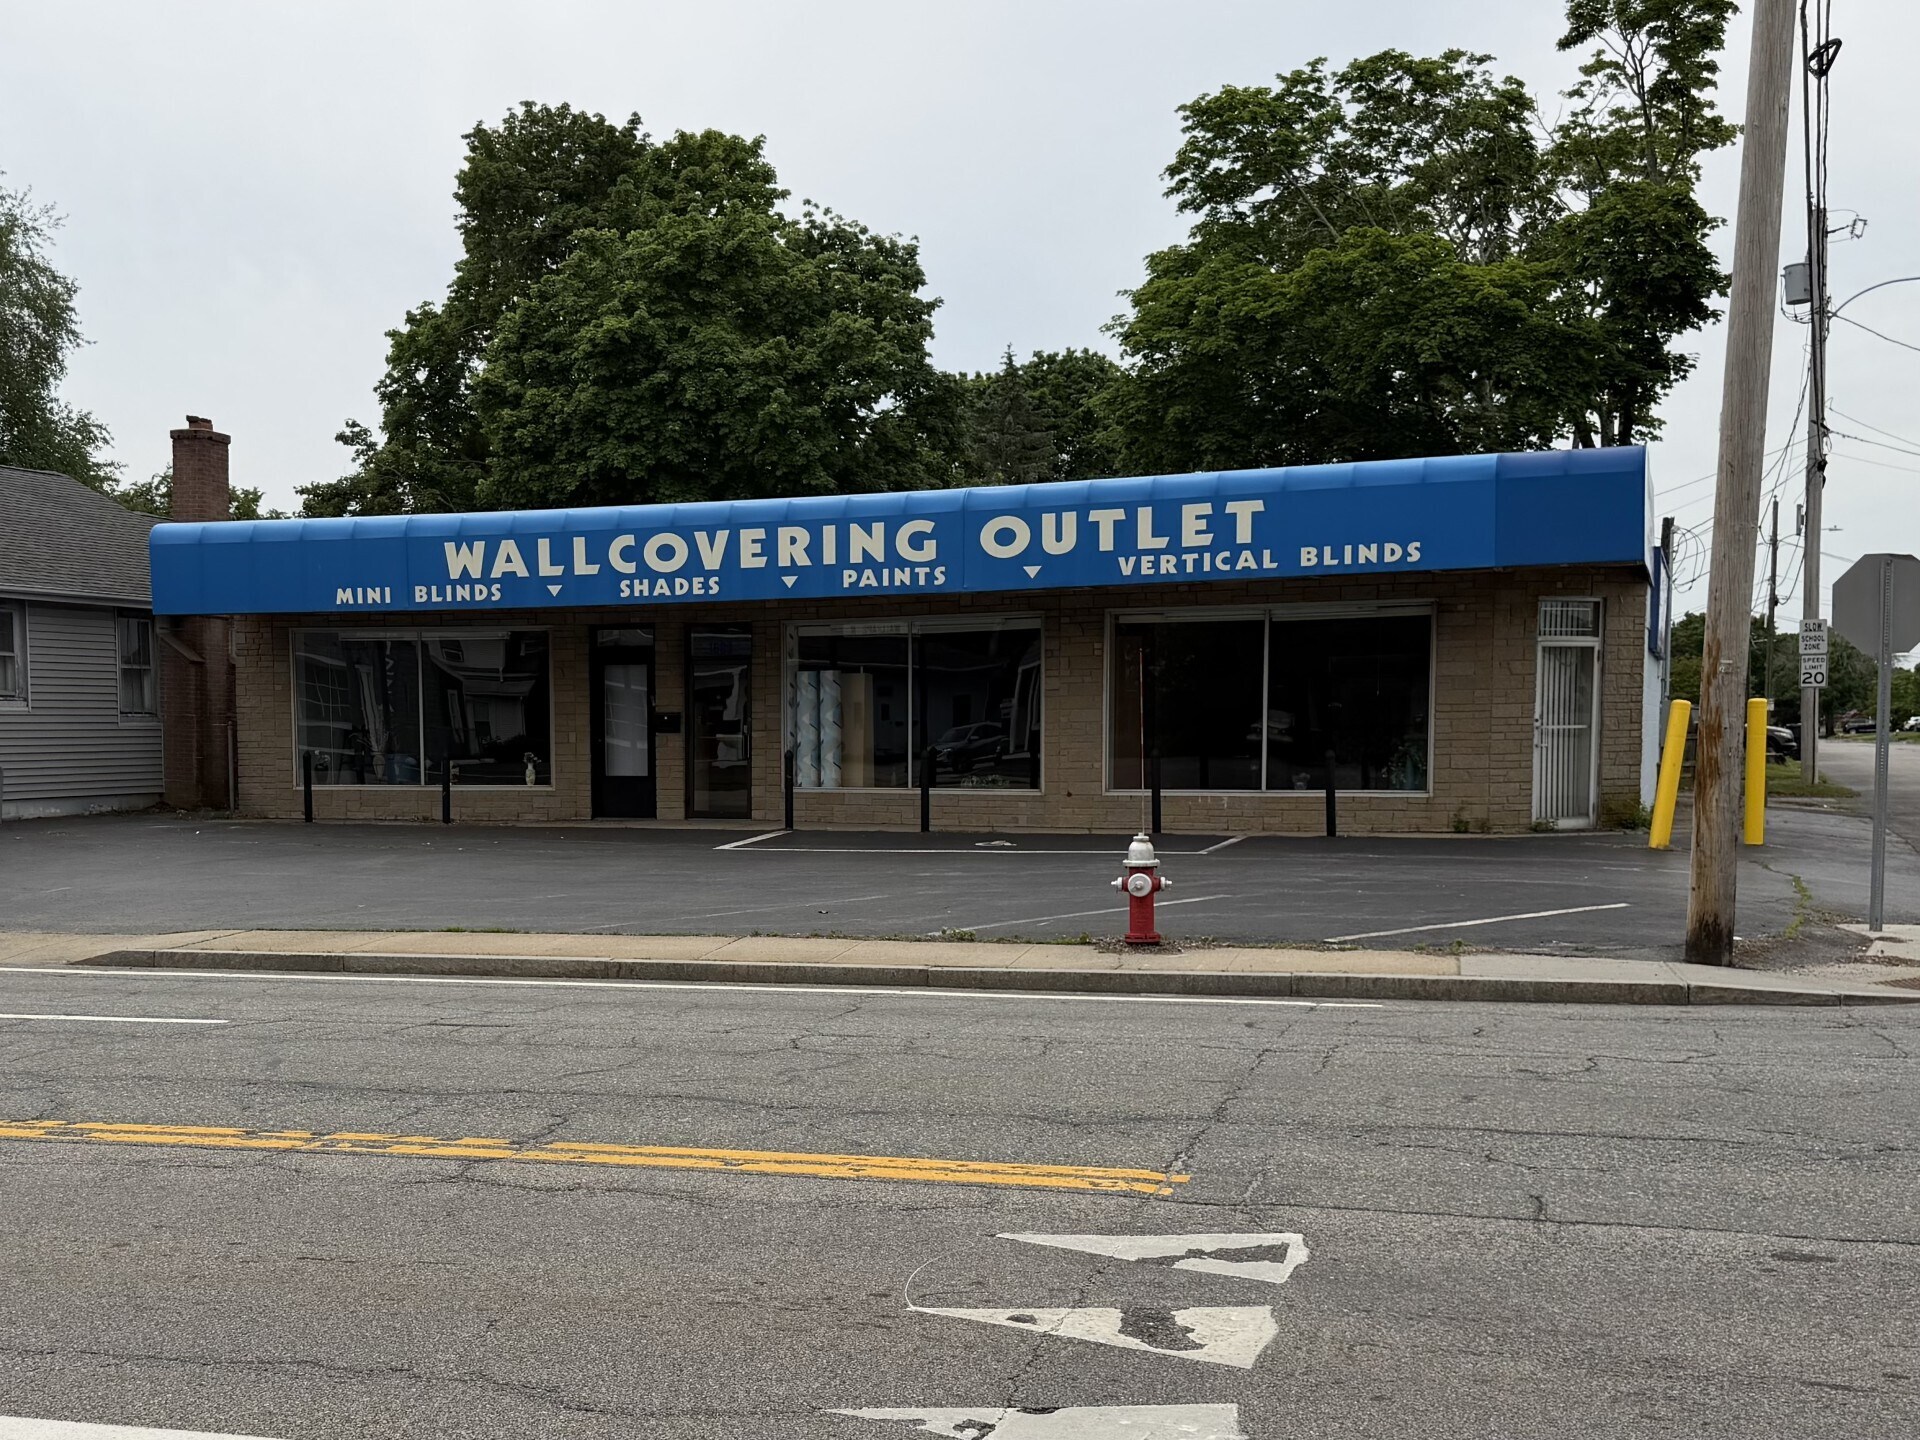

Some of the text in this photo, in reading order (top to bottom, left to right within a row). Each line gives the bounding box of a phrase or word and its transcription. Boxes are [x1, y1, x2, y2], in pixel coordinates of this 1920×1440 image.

[444, 499, 1265, 581] WALLCOVERING OUTLET
[1118, 541, 1422, 577] VERTICAL BLINDS
[619, 576, 721, 598] SHADES
[842, 566, 946, 589] PAINTS
[336, 583, 502, 606] MINI BLINDS
[1804, 622, 1823, 632] SLOW
[1801, 635, 1825, 643] SCHOOL
[1804, 643, 1821, 651] ZONE
[1802, 671, 1825, 685] 20
